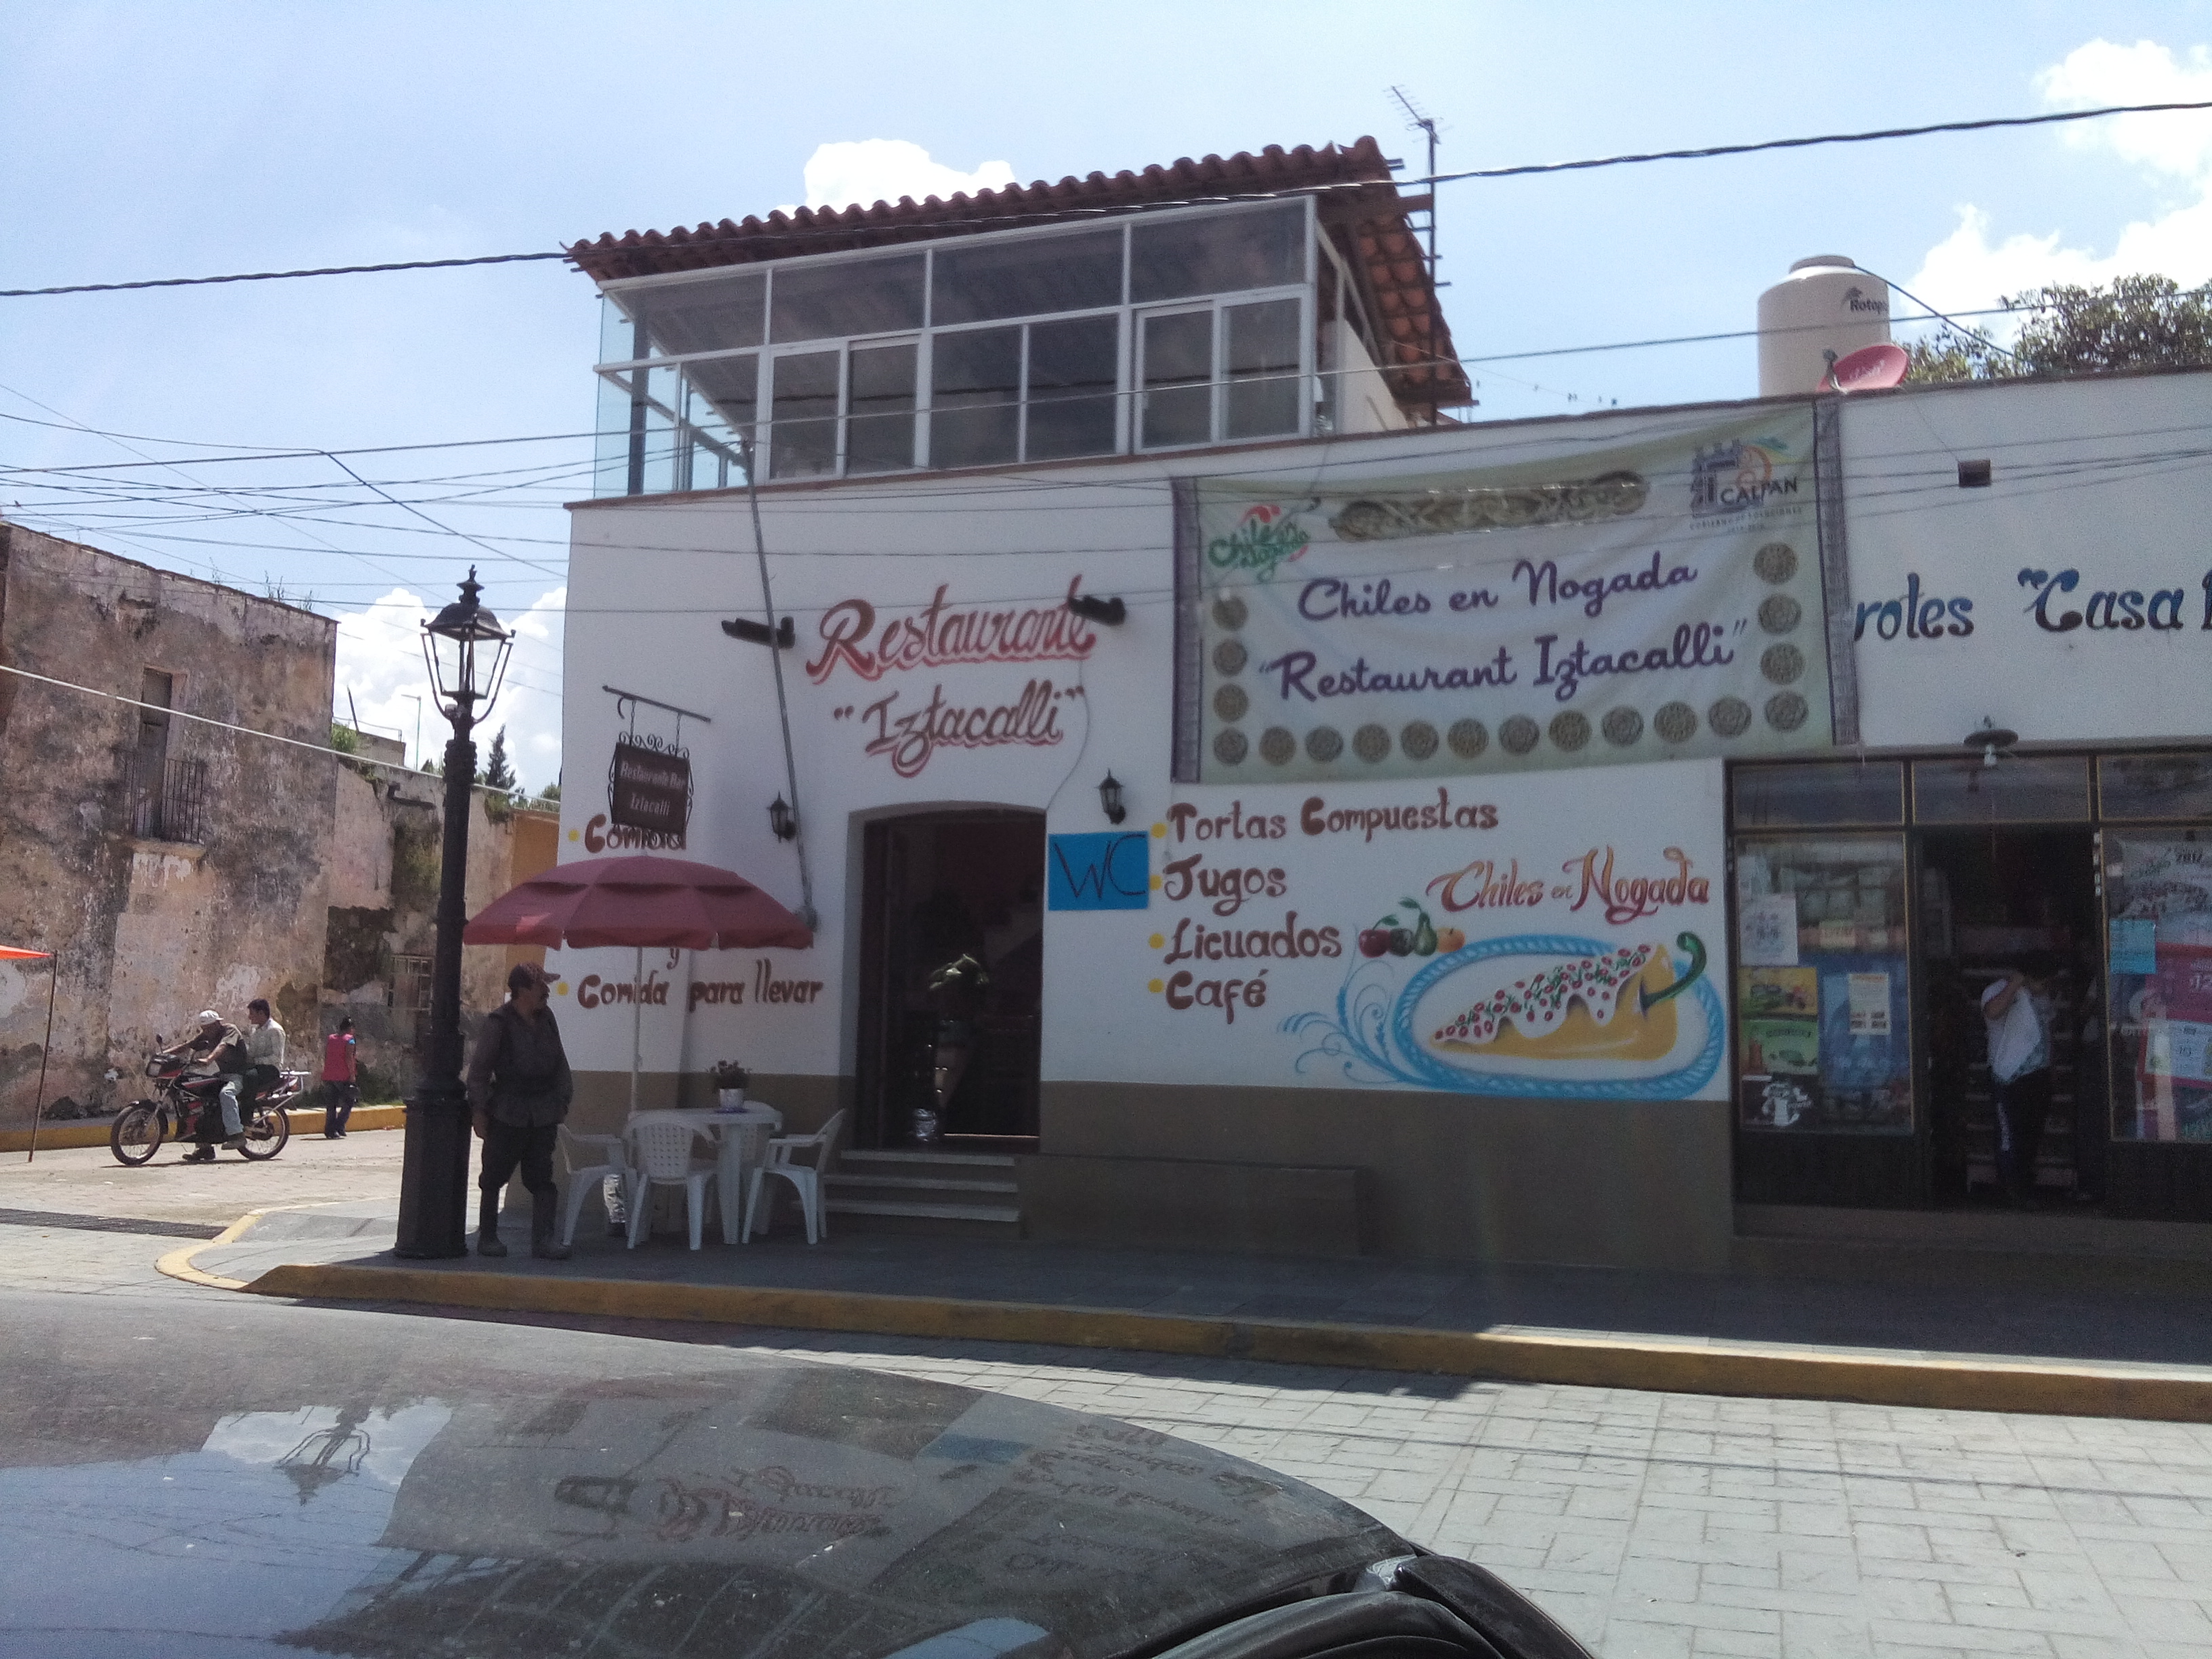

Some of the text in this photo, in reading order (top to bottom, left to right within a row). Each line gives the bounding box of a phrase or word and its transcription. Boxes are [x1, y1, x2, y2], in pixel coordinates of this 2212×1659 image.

[1849, 299, 1889, 315] Rotop
[1298, 551, 1698, 622] Chiles en Nogada
[1166, 787, 1499, 843] Tortas Compuestas
[1052, 834, 1147, 899] WC
[1162, 854, 1288, 915] Jugos
[1425, 844, 1709, 924] Chiles en Nogada
[1163, 911, 1343, 965] Licuados
[577, 958, 823, 1012] Comida para llevar
[1165, 969, 1268, 1023] Café
